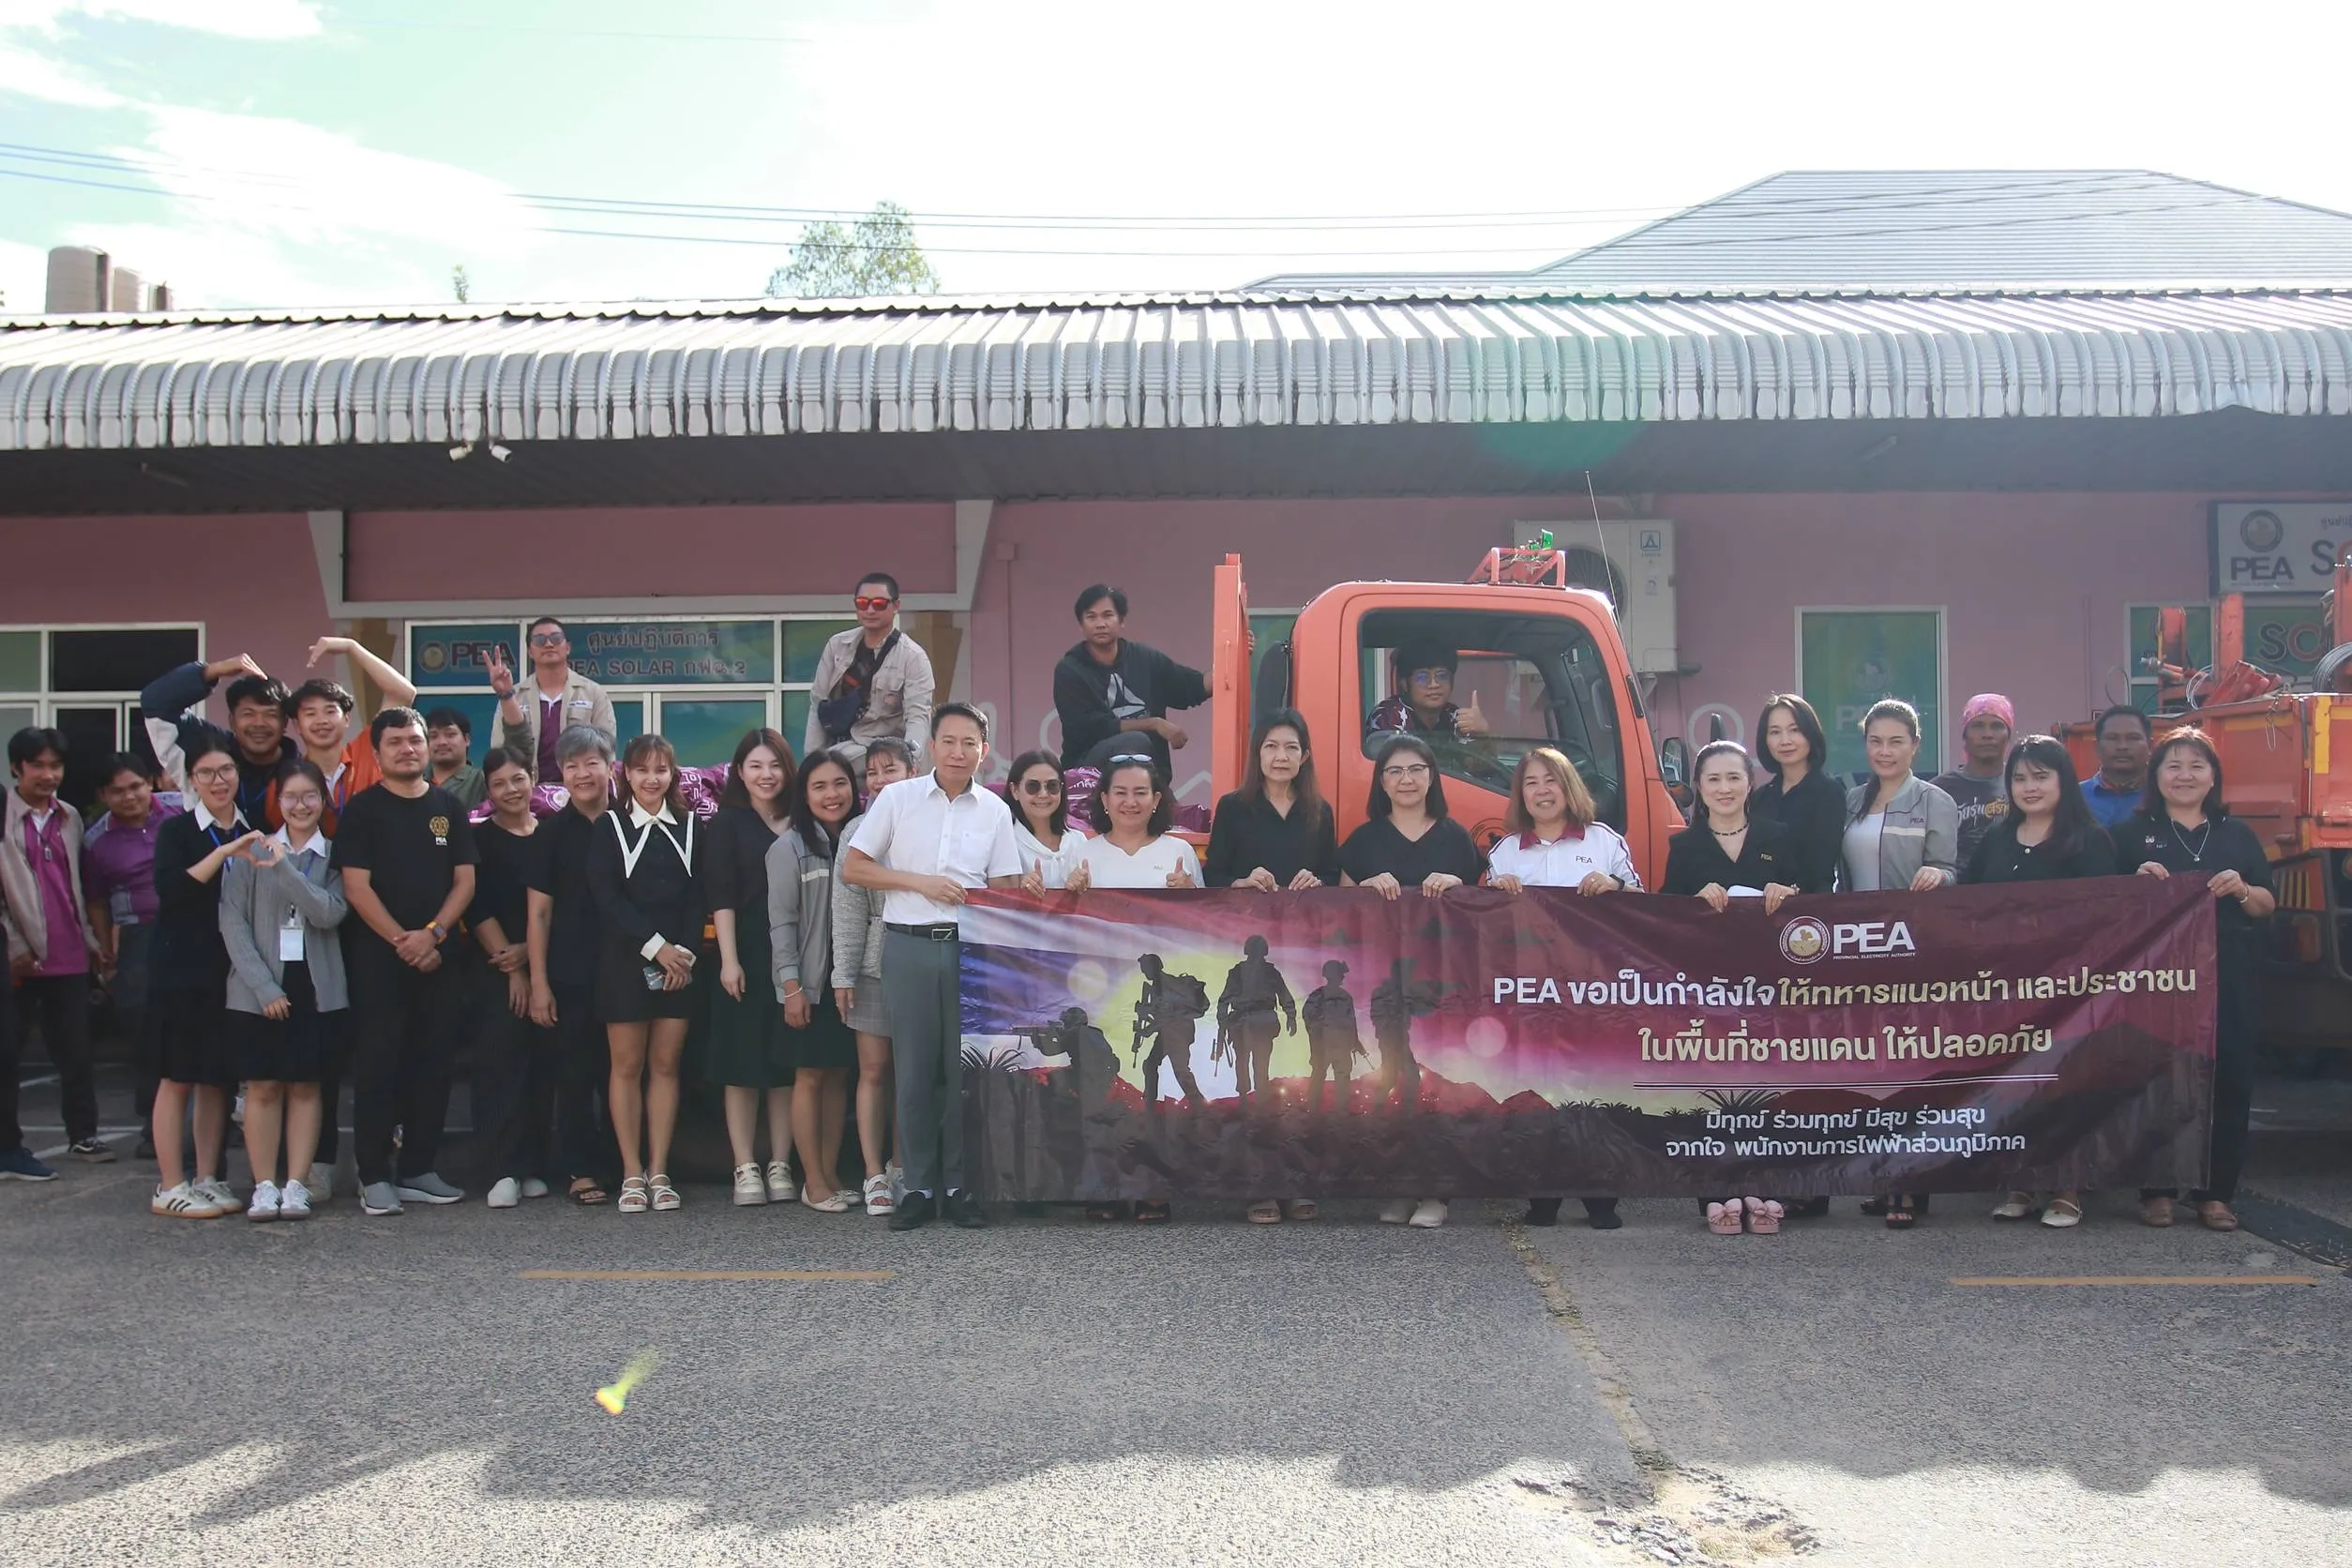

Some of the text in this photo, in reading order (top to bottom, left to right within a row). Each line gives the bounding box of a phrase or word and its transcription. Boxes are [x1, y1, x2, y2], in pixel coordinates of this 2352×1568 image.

[2230, 556, 2295, 580] PEA
[451, 641, 517, 668] PEA
[609, 659, 675, 675] SOLAR
[1833, 921, 1916, 954] PEA
[1494, 977, 1561, 1004] PEA
[2017, 966, 2196, 1000] และประชาชน
[1638, 1019, 2052, 1062] ในพื้นที่ชายแดน ให้ปลอดภัย
[1706, 1105, 1986, 1135] มีทุกข์ ร่วมทุกข์ มีสุข ร่วมสุข
[1666, 1131, 2026, 1158] จากใจ พนักงานการไฟฟ้าส่วนภูมิภาค
